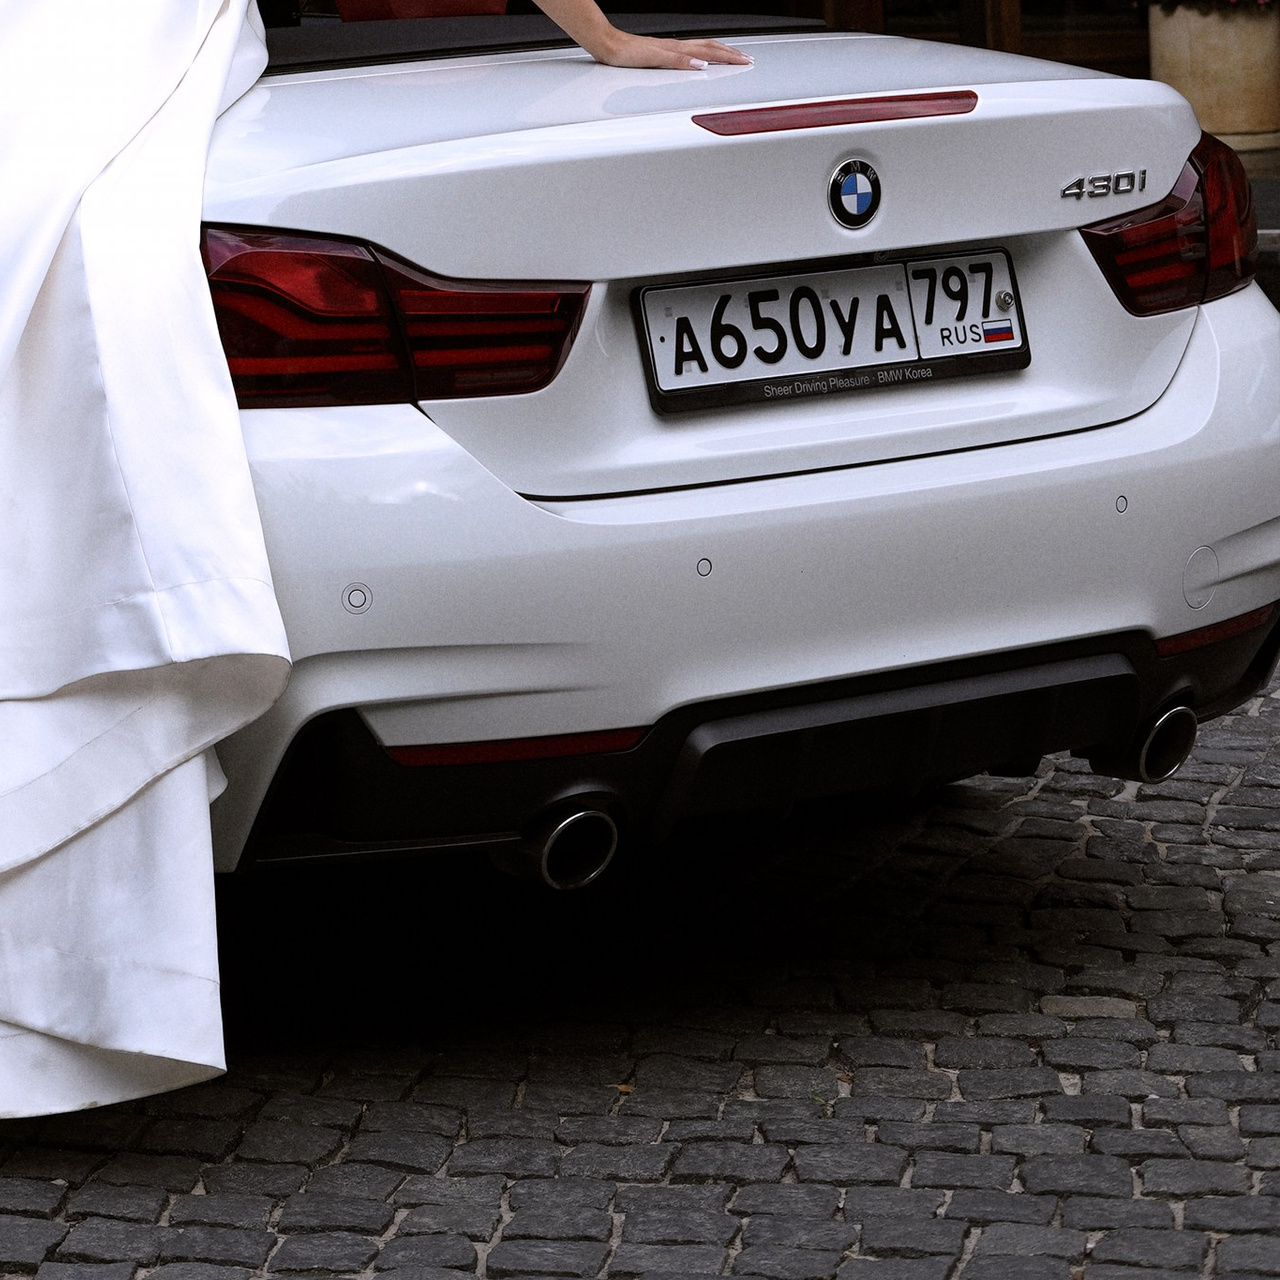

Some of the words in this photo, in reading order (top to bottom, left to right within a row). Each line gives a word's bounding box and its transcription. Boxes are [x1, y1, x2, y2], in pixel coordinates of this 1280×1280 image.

[834, 160, 877, 184] BMW
[1060, 169, 1147, 201] 430i
[911, 262, 993, 326] 797
[939, 324, 982, 347] RUS
[763, 384, 793, 397] Sheer
[794, 380, 827, 394] Driving
[829, 376, 870, 389] Pleasure
[877, 370, 902, 383] BMW
[905, 367, 933, 380] Korea
